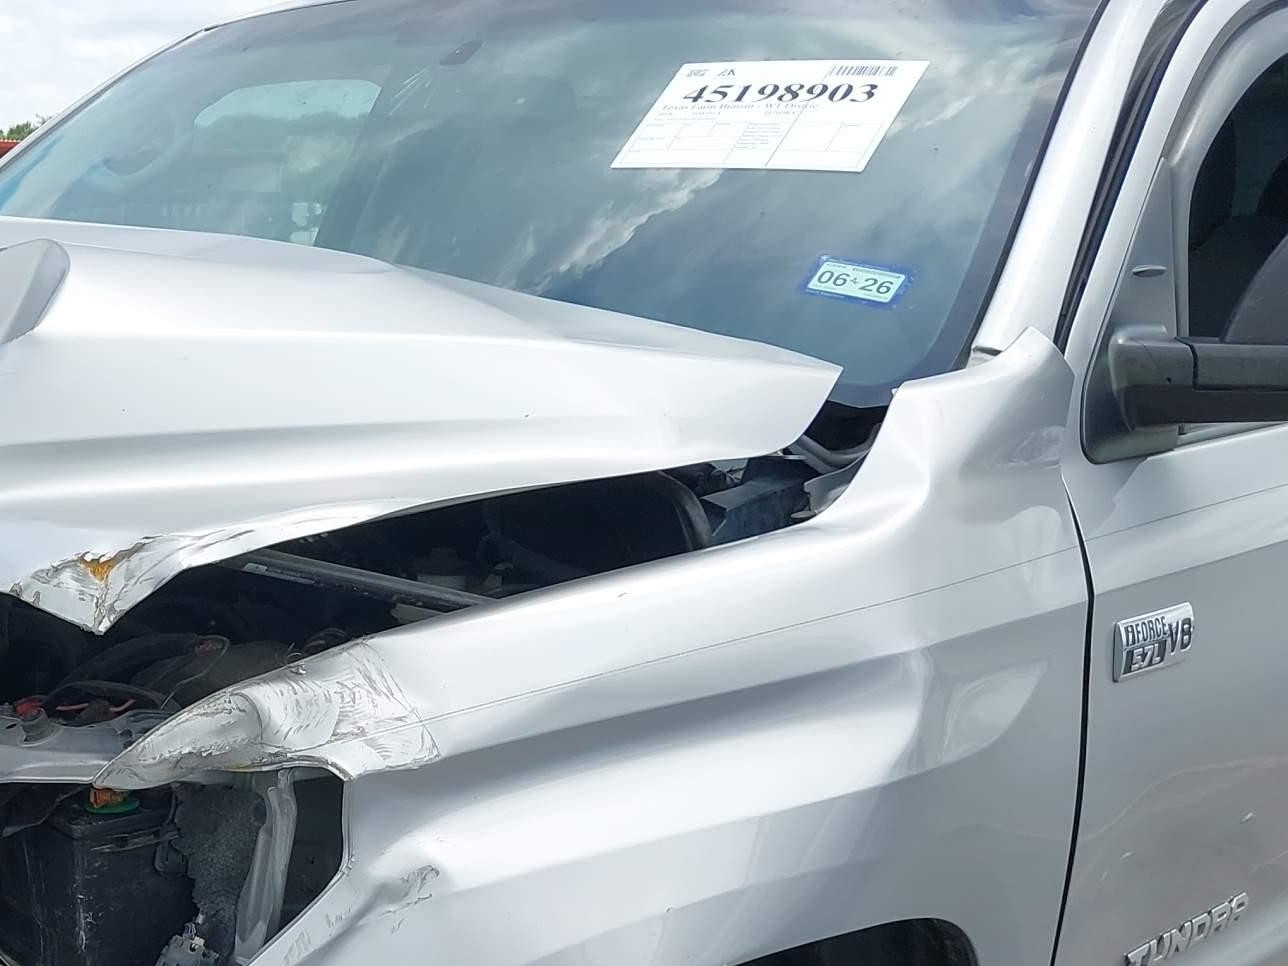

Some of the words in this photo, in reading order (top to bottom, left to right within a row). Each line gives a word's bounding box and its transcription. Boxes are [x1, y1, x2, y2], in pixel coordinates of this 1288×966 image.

[682, 83, 879, 103] 45198903
[817, 270, 850, 287] 06
[859, 277, 893, 295] 26
[1168, 617, 1193, 655] V8
